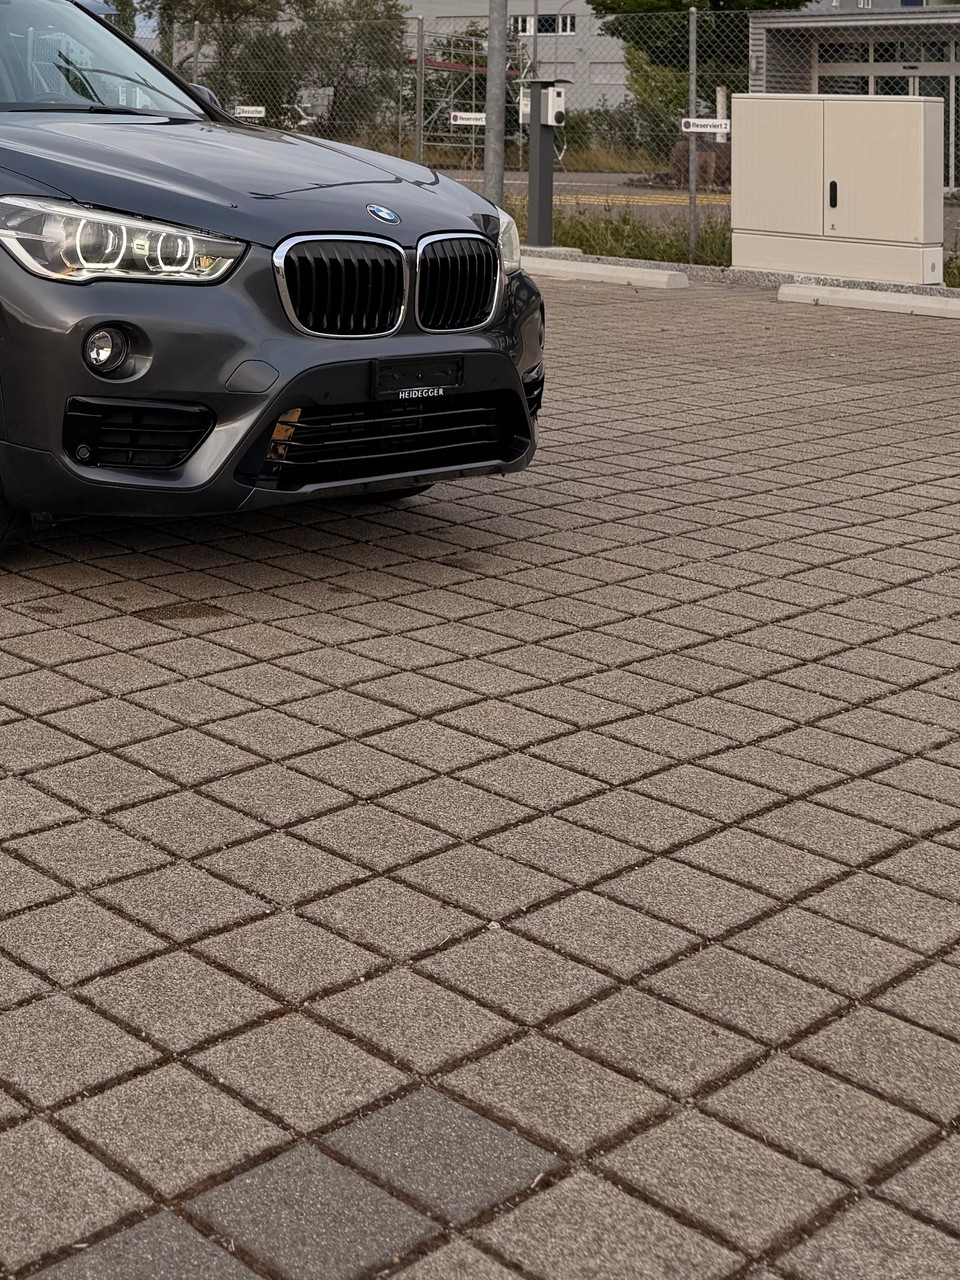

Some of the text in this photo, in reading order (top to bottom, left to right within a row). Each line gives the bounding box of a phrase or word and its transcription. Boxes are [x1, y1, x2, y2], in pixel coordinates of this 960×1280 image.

[692, 121, 729, 130] Reserviert 2
[399, 388, 444, 400] HEIDEGGER
